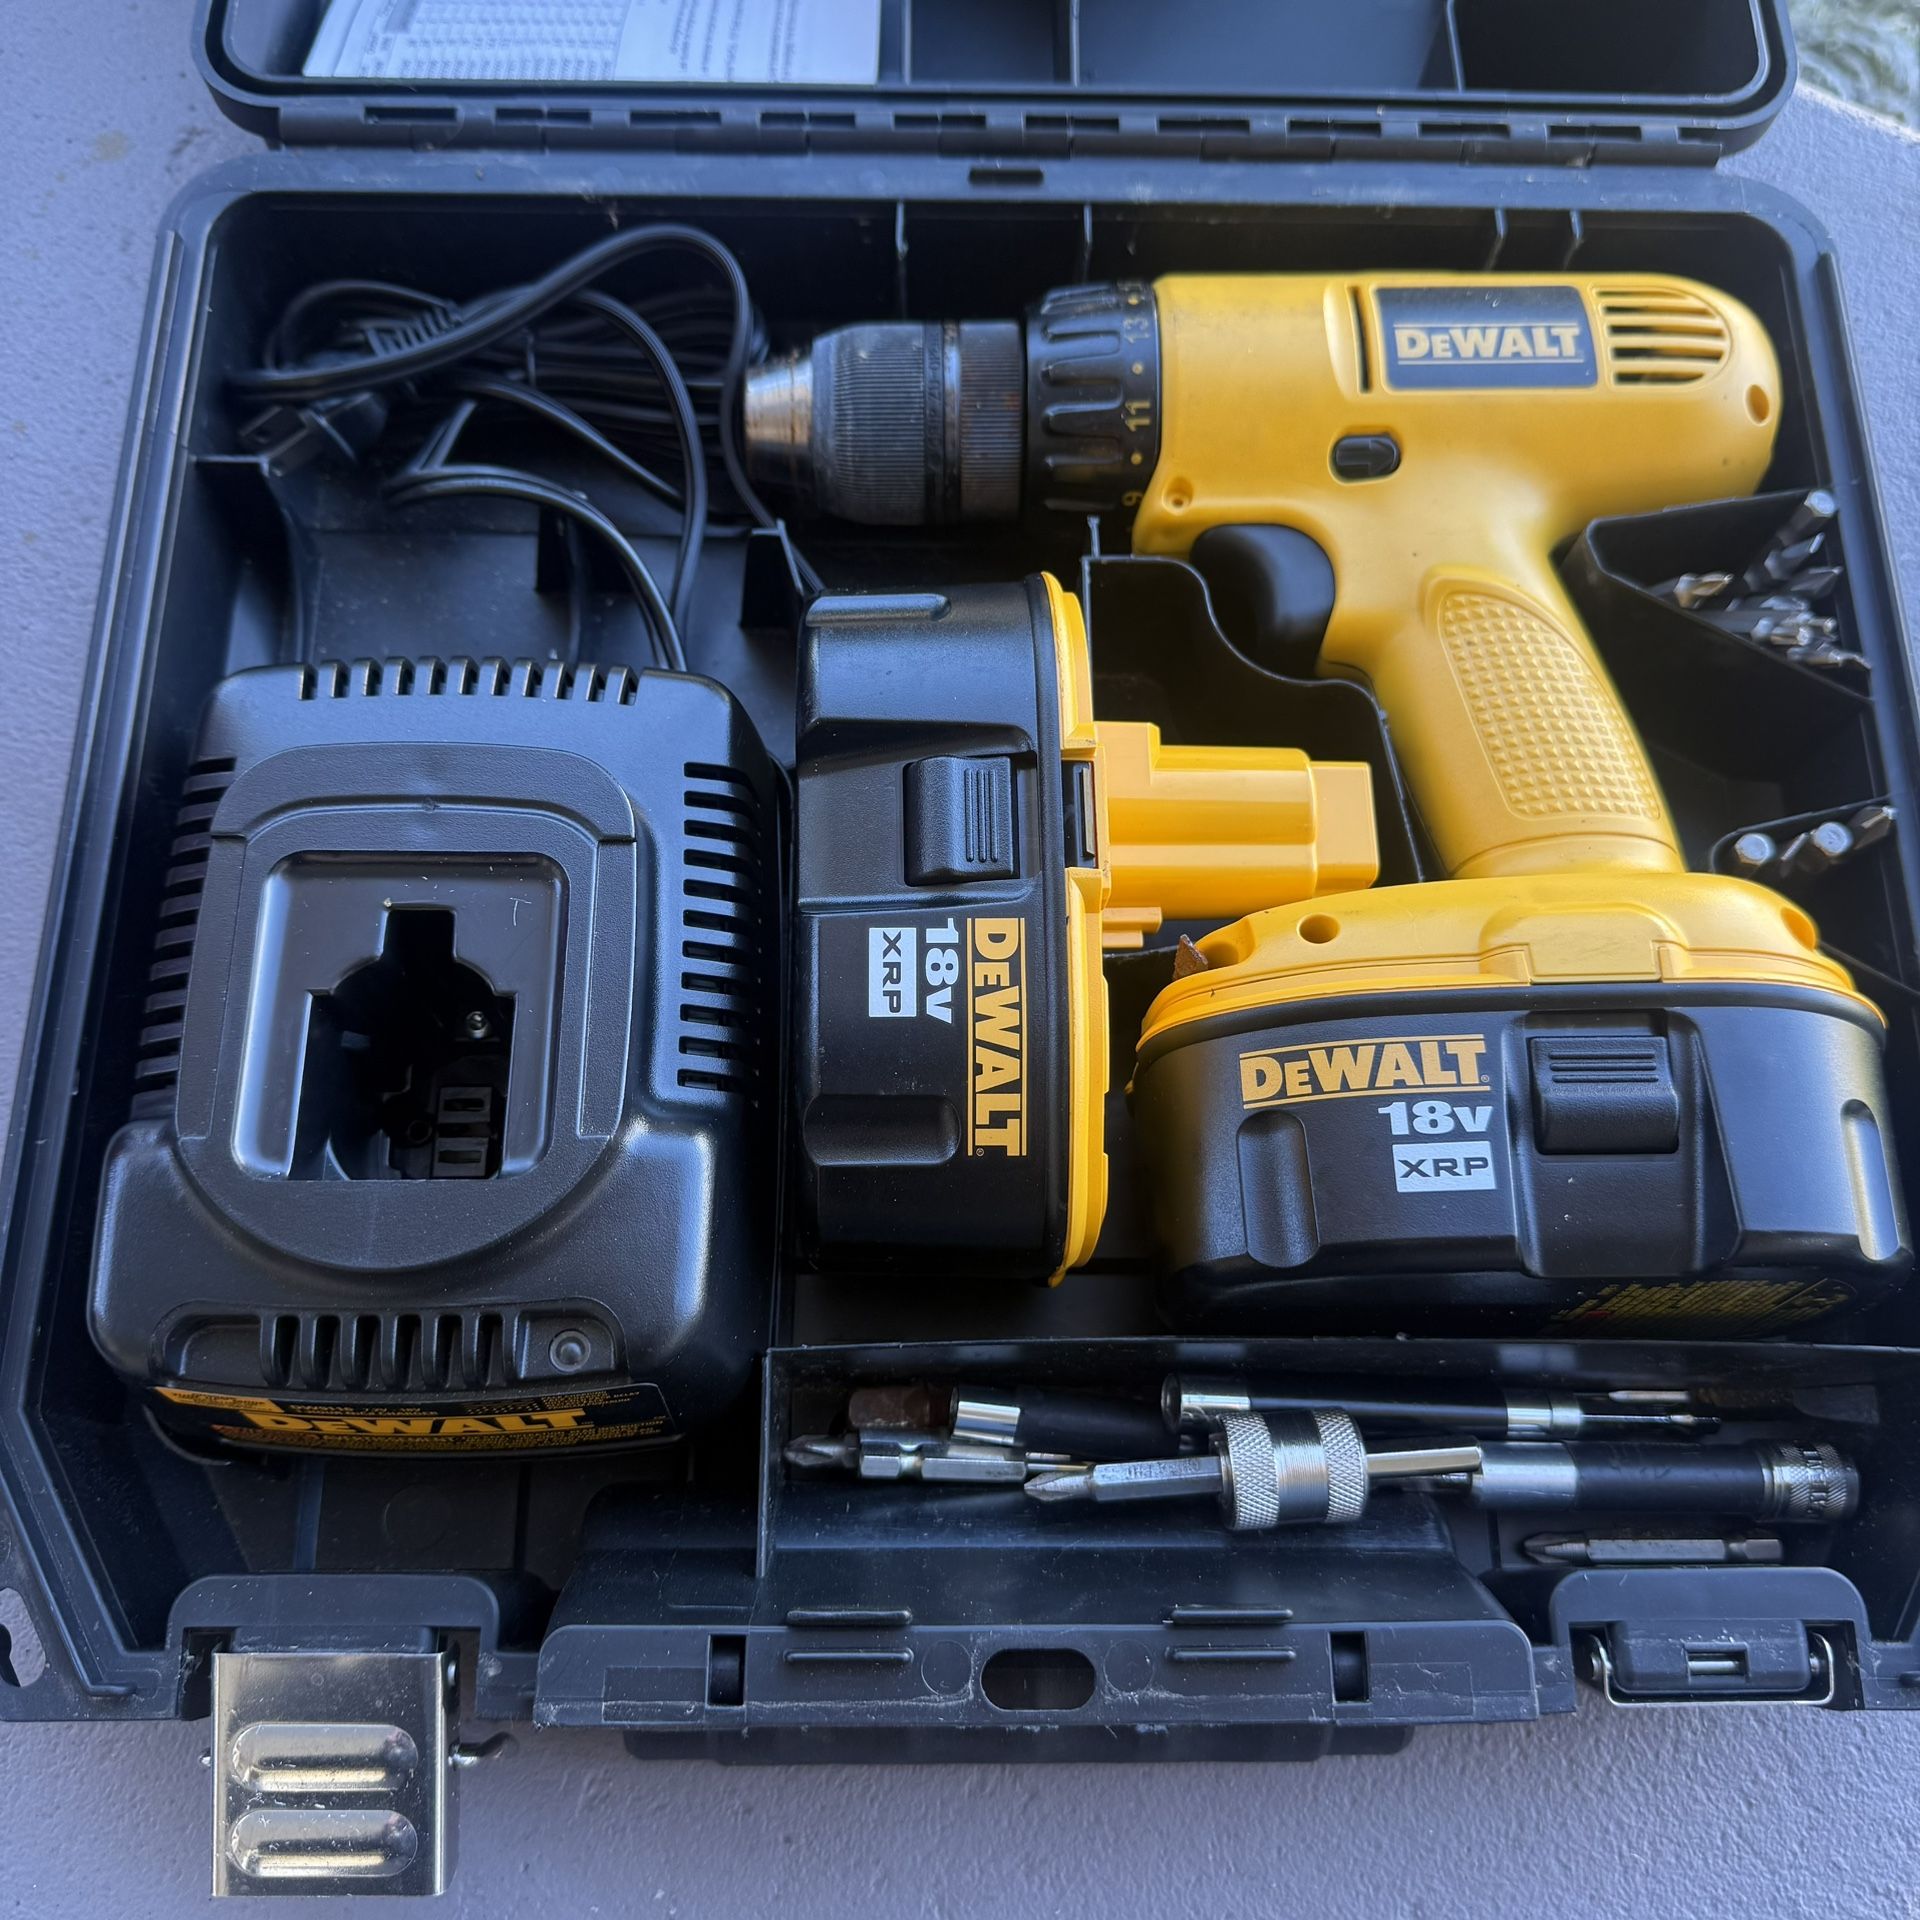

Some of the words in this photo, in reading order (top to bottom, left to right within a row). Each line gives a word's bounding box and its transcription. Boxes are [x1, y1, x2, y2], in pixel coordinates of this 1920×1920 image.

[1122, 315, 1151, 344] 13
[1394, 327, 1580, 359] DEWALT
[1124, 399, 1152, 432] 11
[882, 931, 902, 1014] XRP
[974, 917, 1021, 1157] DEWALT
[1238, 1040, 1487, 1102] DEWALT
[1398, 1156, 1490, 1179] XRP
[242, 1408, 587, 1434] DEWALT
